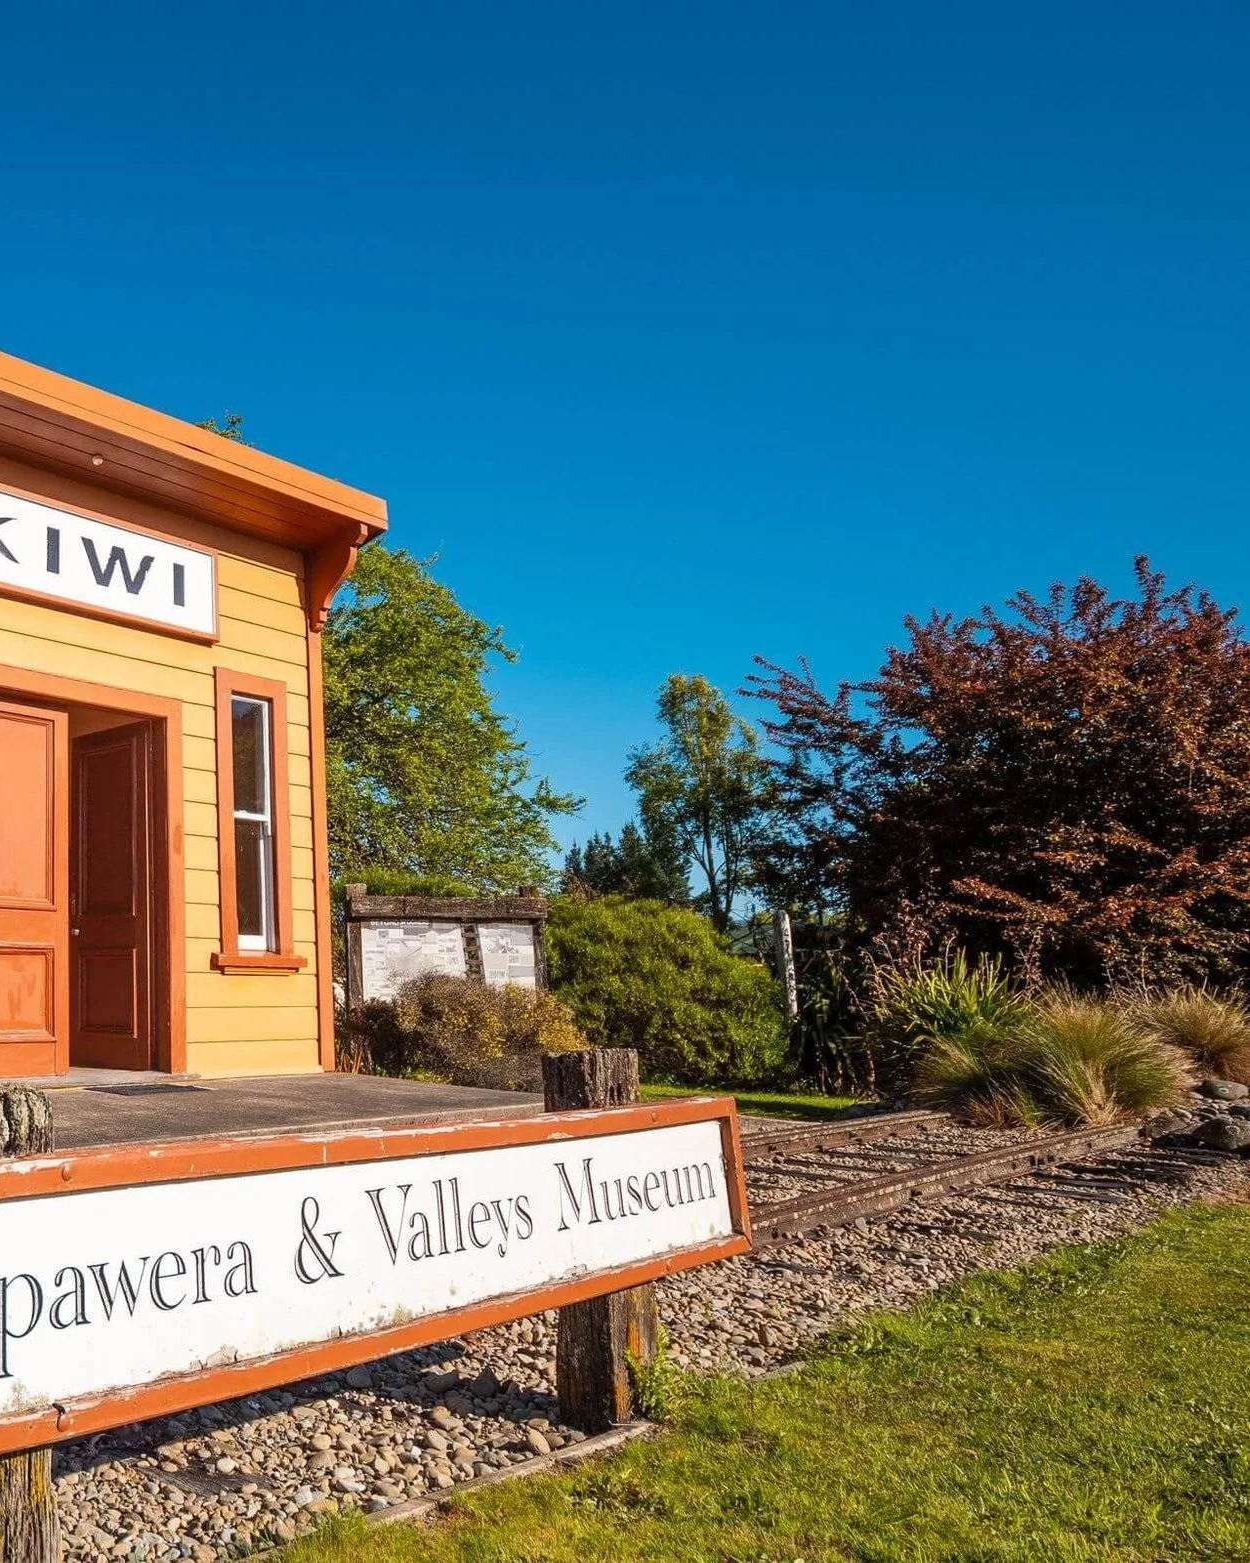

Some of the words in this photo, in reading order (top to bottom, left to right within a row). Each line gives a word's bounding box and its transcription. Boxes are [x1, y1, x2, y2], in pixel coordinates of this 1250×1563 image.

[294, 1196, 345, 1285] &
[364, 1177, 533, 1266] Valleys
[552, 1156, 718, 1233] Museum
